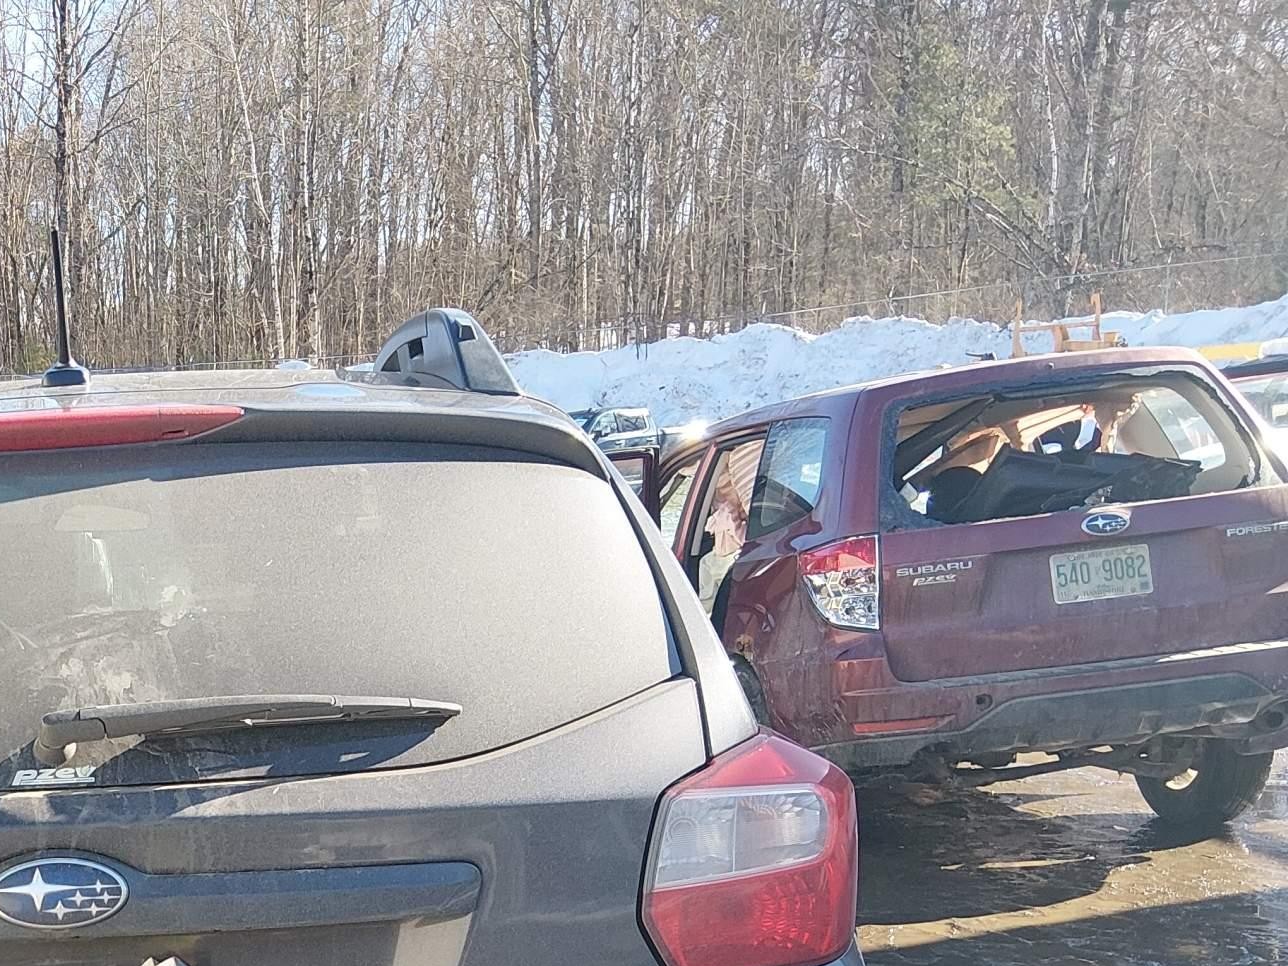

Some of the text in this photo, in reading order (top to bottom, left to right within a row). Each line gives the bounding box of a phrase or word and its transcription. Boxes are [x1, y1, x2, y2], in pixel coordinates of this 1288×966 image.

[1226, 521, 1288, 537] FORESTE
[896, 560, 973, 577] SUBARU
[1056, 554, 1147, 587] 540 9082
